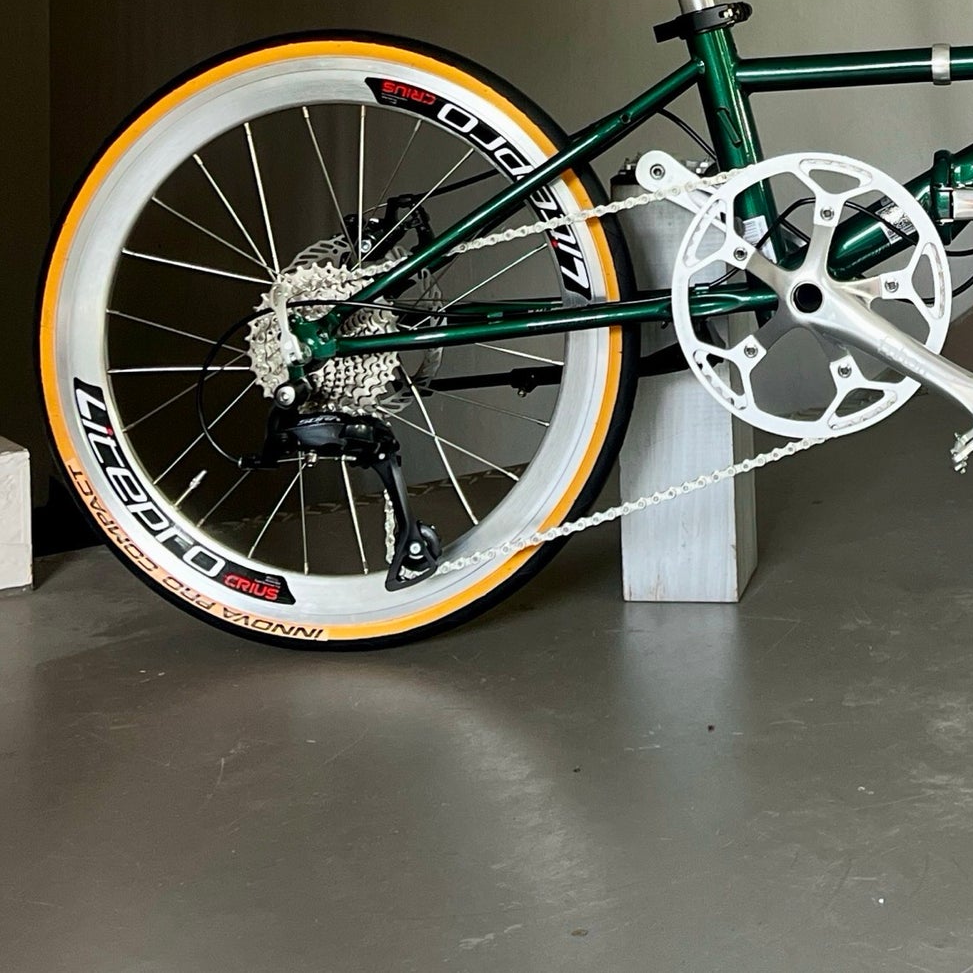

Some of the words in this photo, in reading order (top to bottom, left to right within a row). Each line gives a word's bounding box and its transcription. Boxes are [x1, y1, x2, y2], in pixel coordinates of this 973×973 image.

[381, 81, 436, 106] CRIUS
[68, 465, 158, 572] COMPACT
[162, 576, 216, 610] PRO
[222, 573, 280, 601] CRIUS
[223, 607, 324, 640] INNOVA
